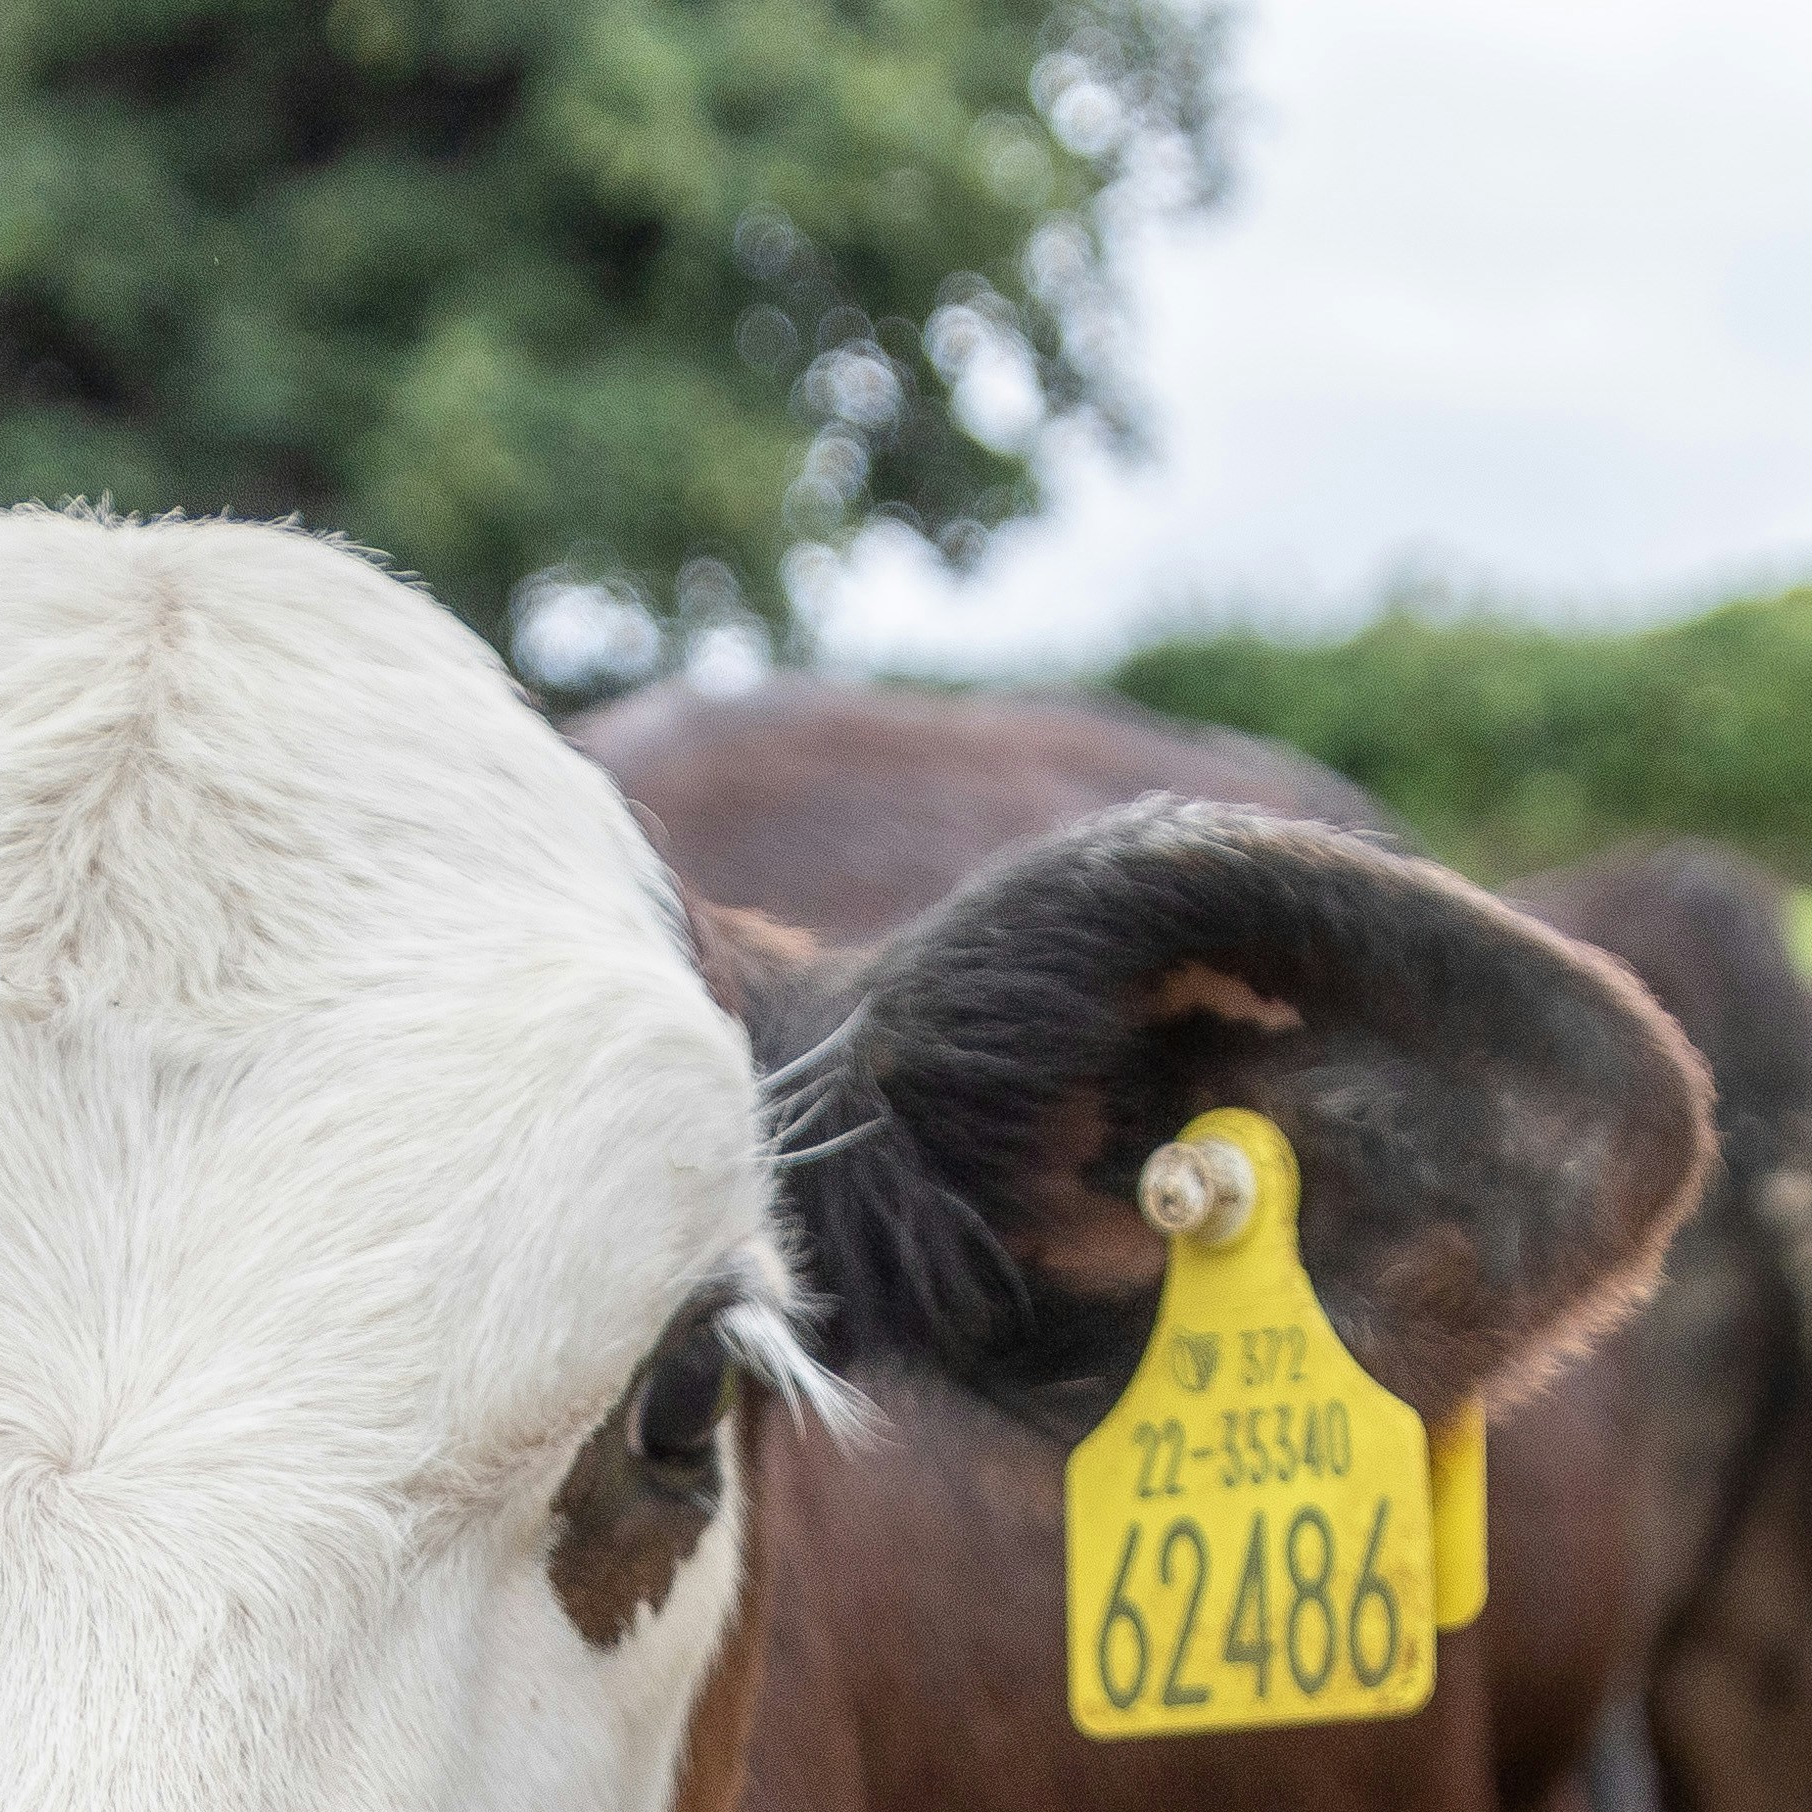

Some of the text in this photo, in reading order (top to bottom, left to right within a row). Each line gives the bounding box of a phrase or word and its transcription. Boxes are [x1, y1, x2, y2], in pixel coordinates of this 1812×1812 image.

[1239, 1325, 1308, 1386] 372
[1133, 1399, 1352, 1498] 22-35340
[1099, 1498, 1398, 1709] 62486
